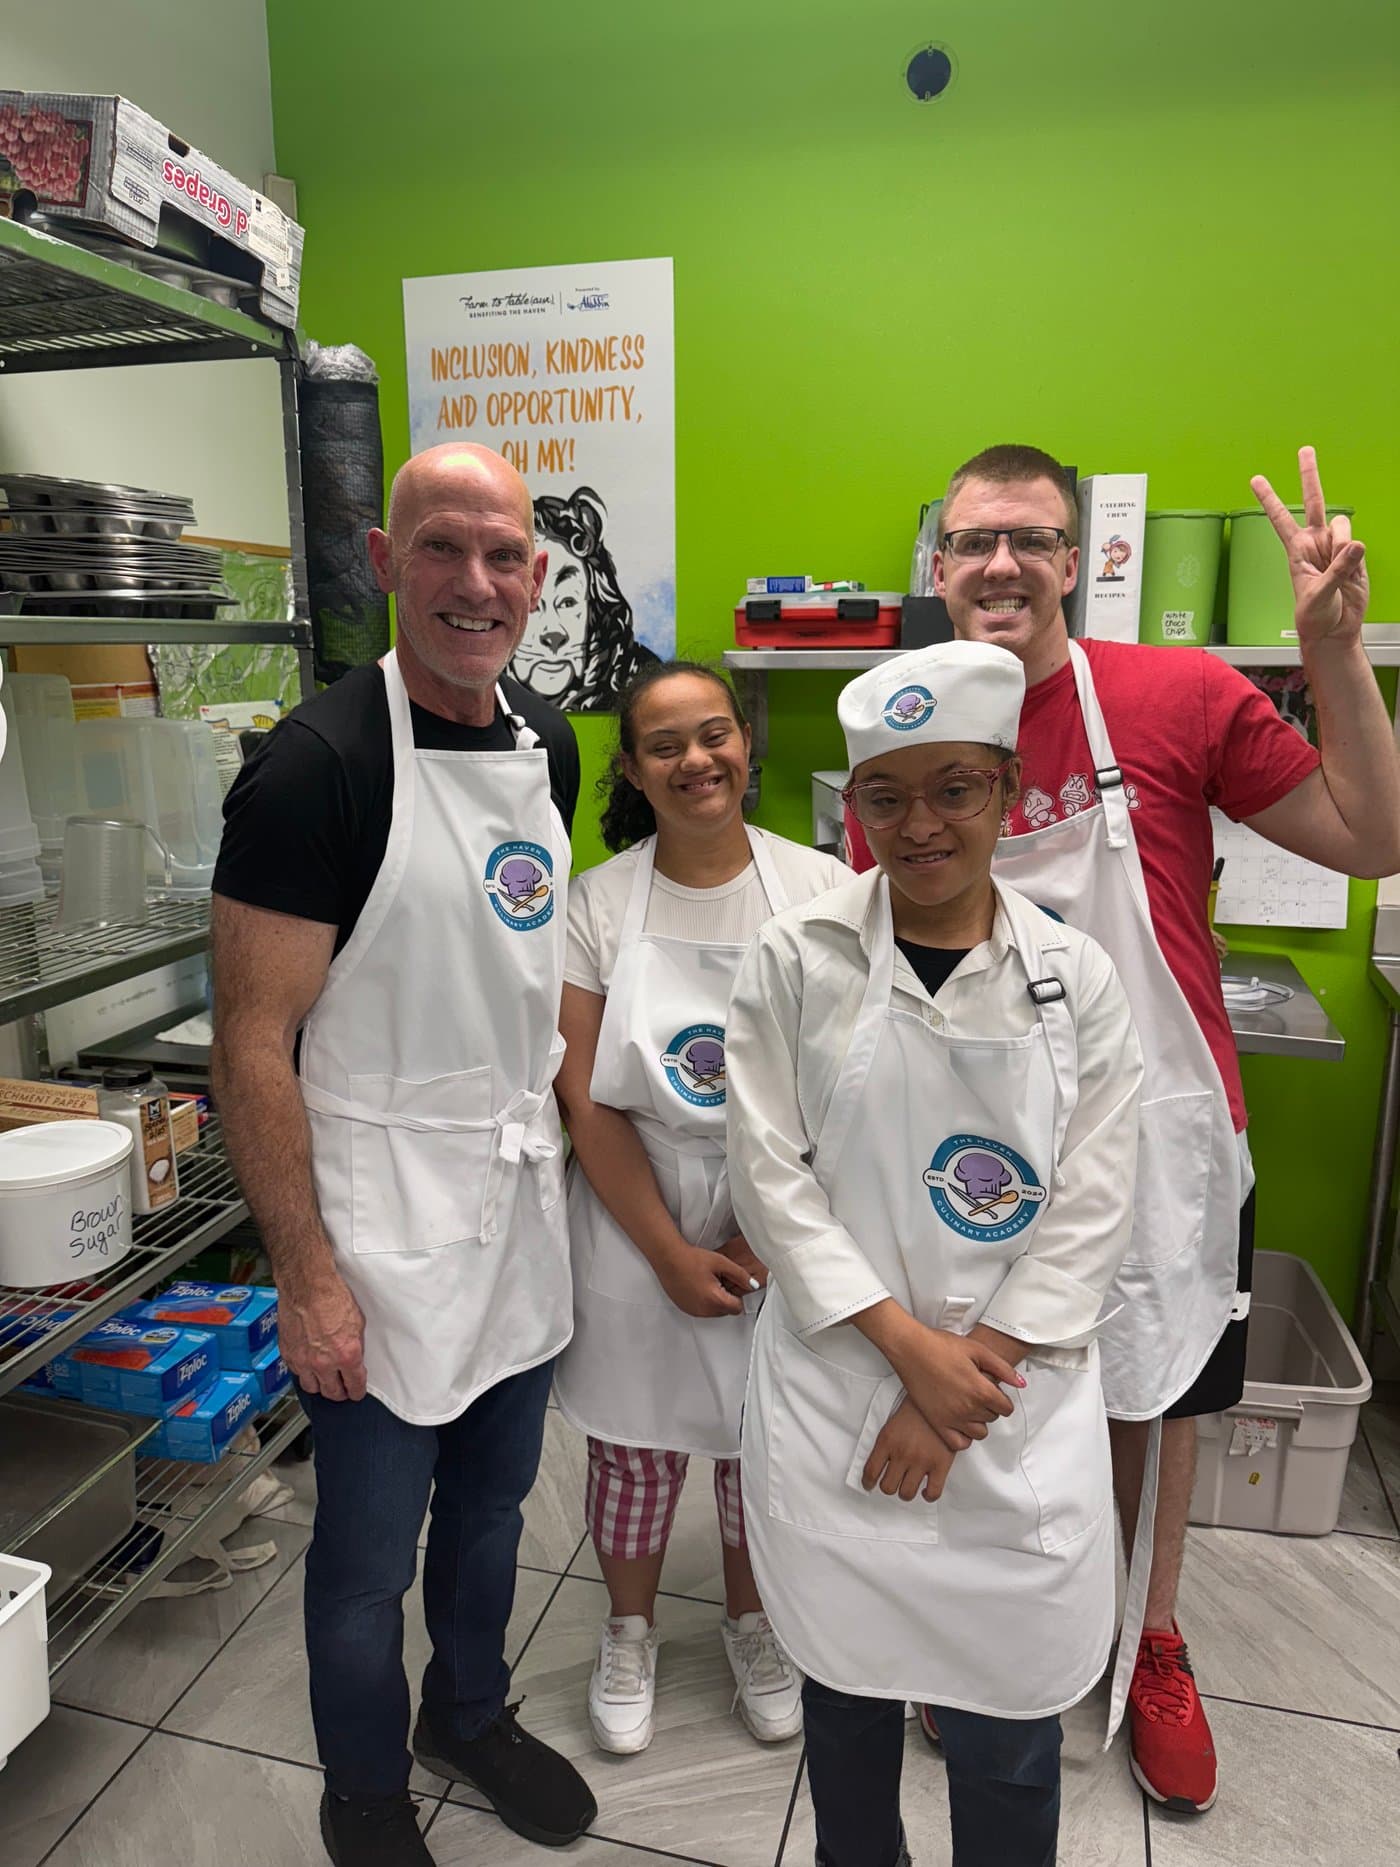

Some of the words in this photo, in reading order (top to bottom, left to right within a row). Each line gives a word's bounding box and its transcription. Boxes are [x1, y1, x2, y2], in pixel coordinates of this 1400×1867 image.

[162, 158, 232, 228] Grapes
[459, 295, 488, 310] Farm
[491, 297, 504, 308] to
[469, 310, 507, 318] BENEFITING
[431, 341, 537, 382] INCLUSION,
[546, 334, 645, 375] KINDNESS
[437, 394, 478, 430] AND
[486, 385, 642, 427] OPPORTUNITY,
[502, 440, 529, 473] OH
[537, 438, 576, 474] MY!
[496, 845, 510, 856] THE
[512, 845, 542, 856] HAVEN
[52, 1098, 87, 1109] PAPER
[953, 1137, 973, 1146] THE
[976, 1138, 1013, 1157] HAVEN
[927, 1174, 945, 1182] ESTD
[71, 1195, 121, 1232] Brown
[936, 1200, 981, 1237] CULINARY
[985, 1211, 1029, 1238] ACADEMY
[70, 1210, 124, 1258] Sugar
[173, 1285, 215, 1297] Ziploc
[99, 1322, 142, 1337] Ziploc
[260, 1311, 278, 1334] Ziplo
[179, 1354, 208, 1381] Ziploc
[226, 1393, 251, 1424] Ziploc
